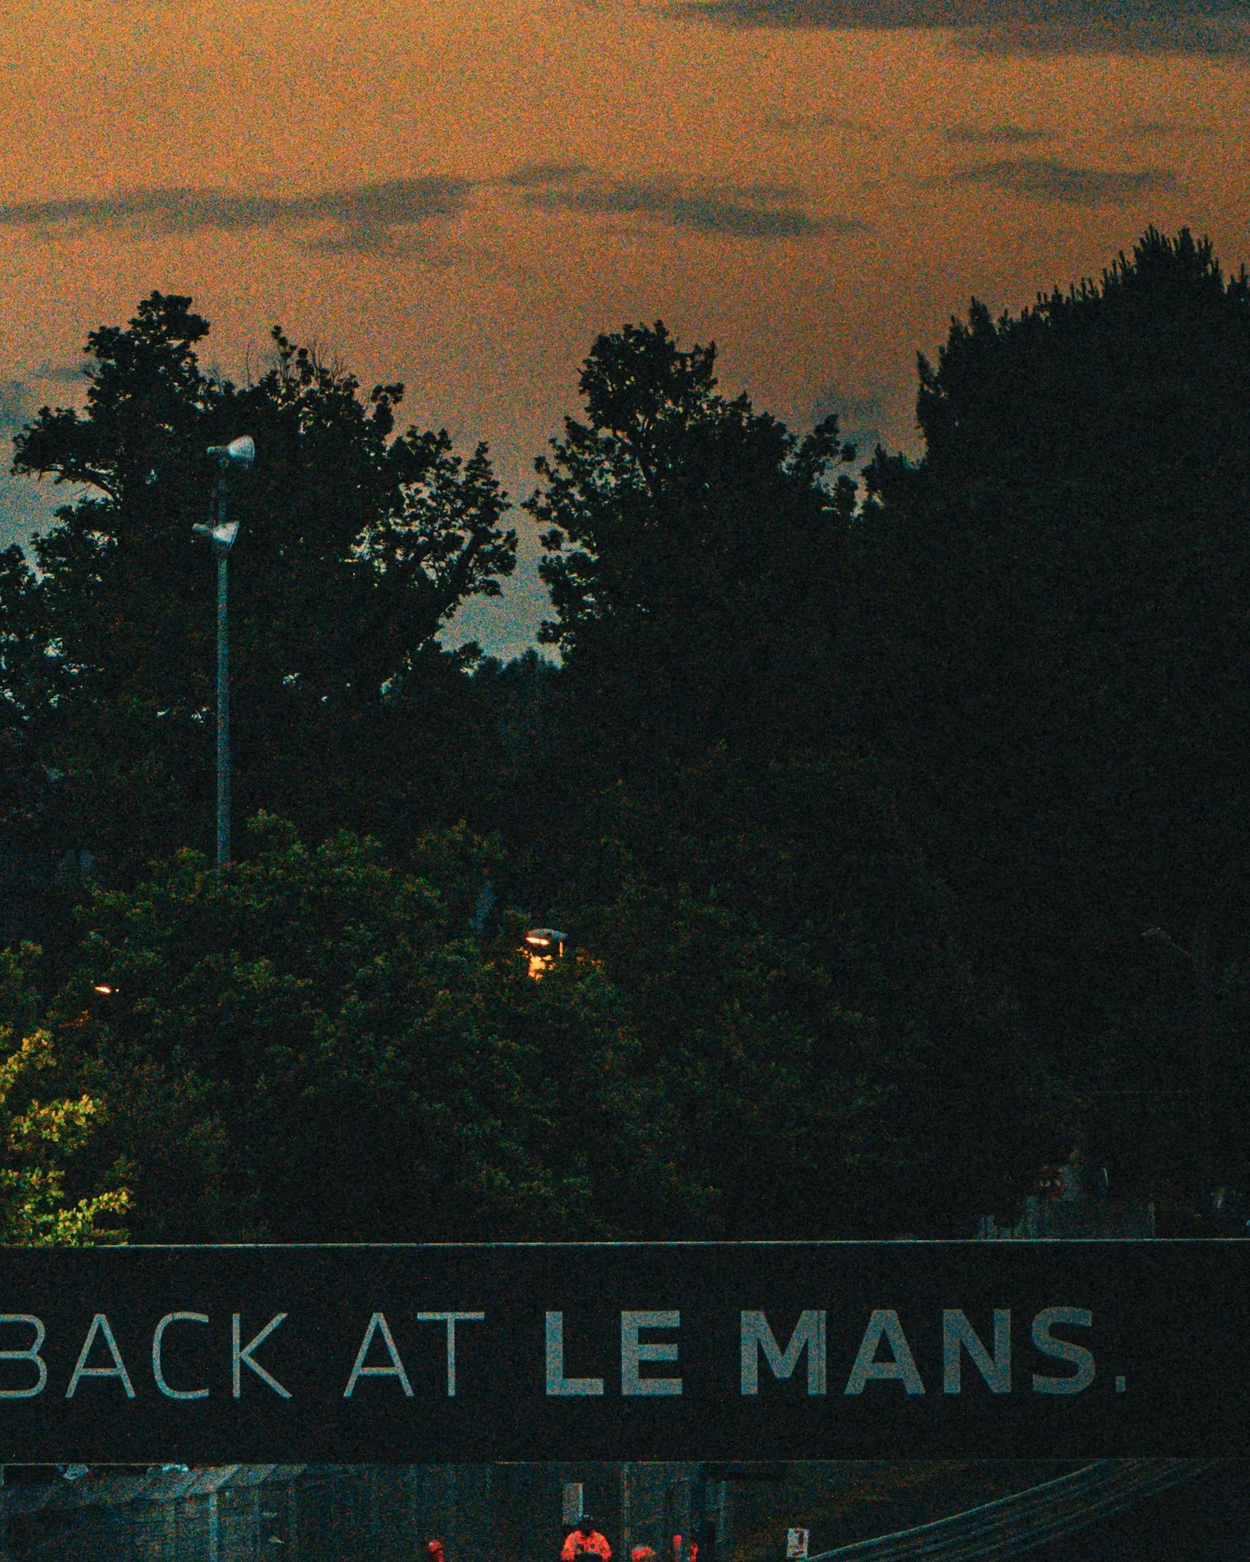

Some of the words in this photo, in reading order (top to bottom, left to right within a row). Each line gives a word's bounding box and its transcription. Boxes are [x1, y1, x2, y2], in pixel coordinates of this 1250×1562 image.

[343, 1311, 485, 1398] AT
[545, 1310, 683, 1397] LE
[741, 1307, 1128, 1396] MANS.
